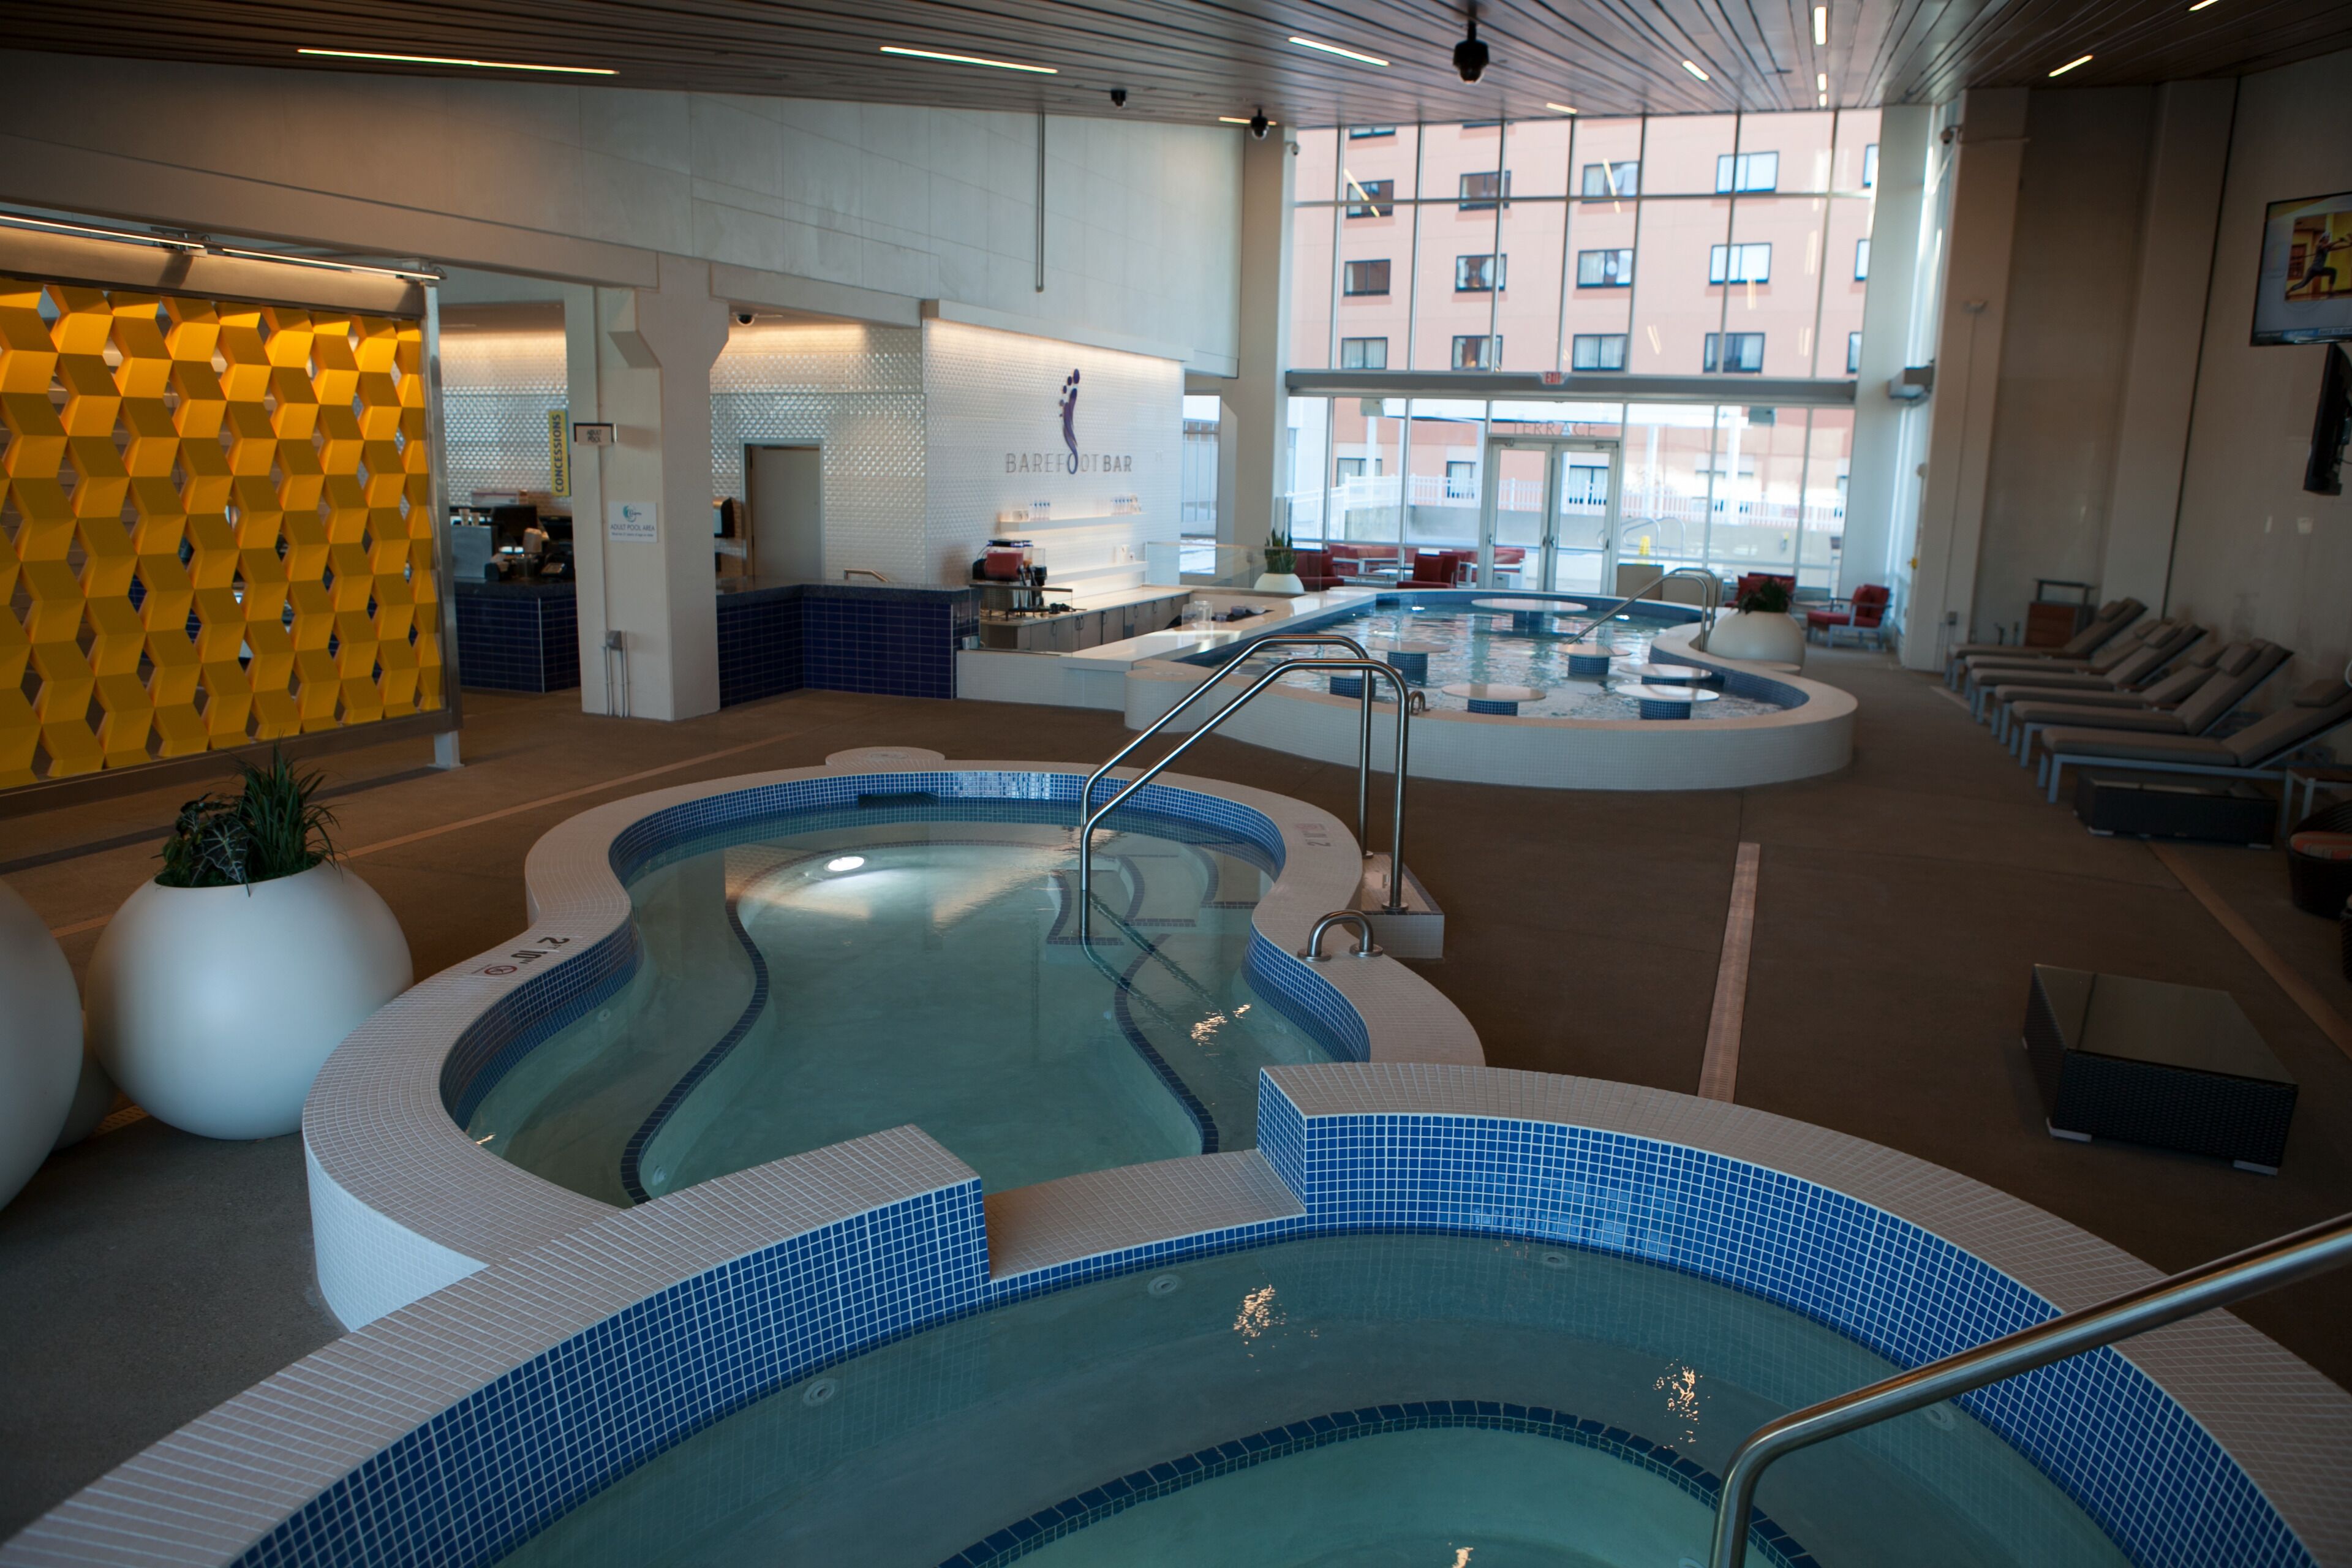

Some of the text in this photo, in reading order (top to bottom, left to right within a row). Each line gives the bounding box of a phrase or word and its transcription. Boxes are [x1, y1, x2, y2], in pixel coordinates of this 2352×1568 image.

[1513, 421, 1596, 435] TERRACE
[552, 414, 564, 492] CONCESSIONS
[1006, 453, 1132, 474] BAREFOOT BAR
